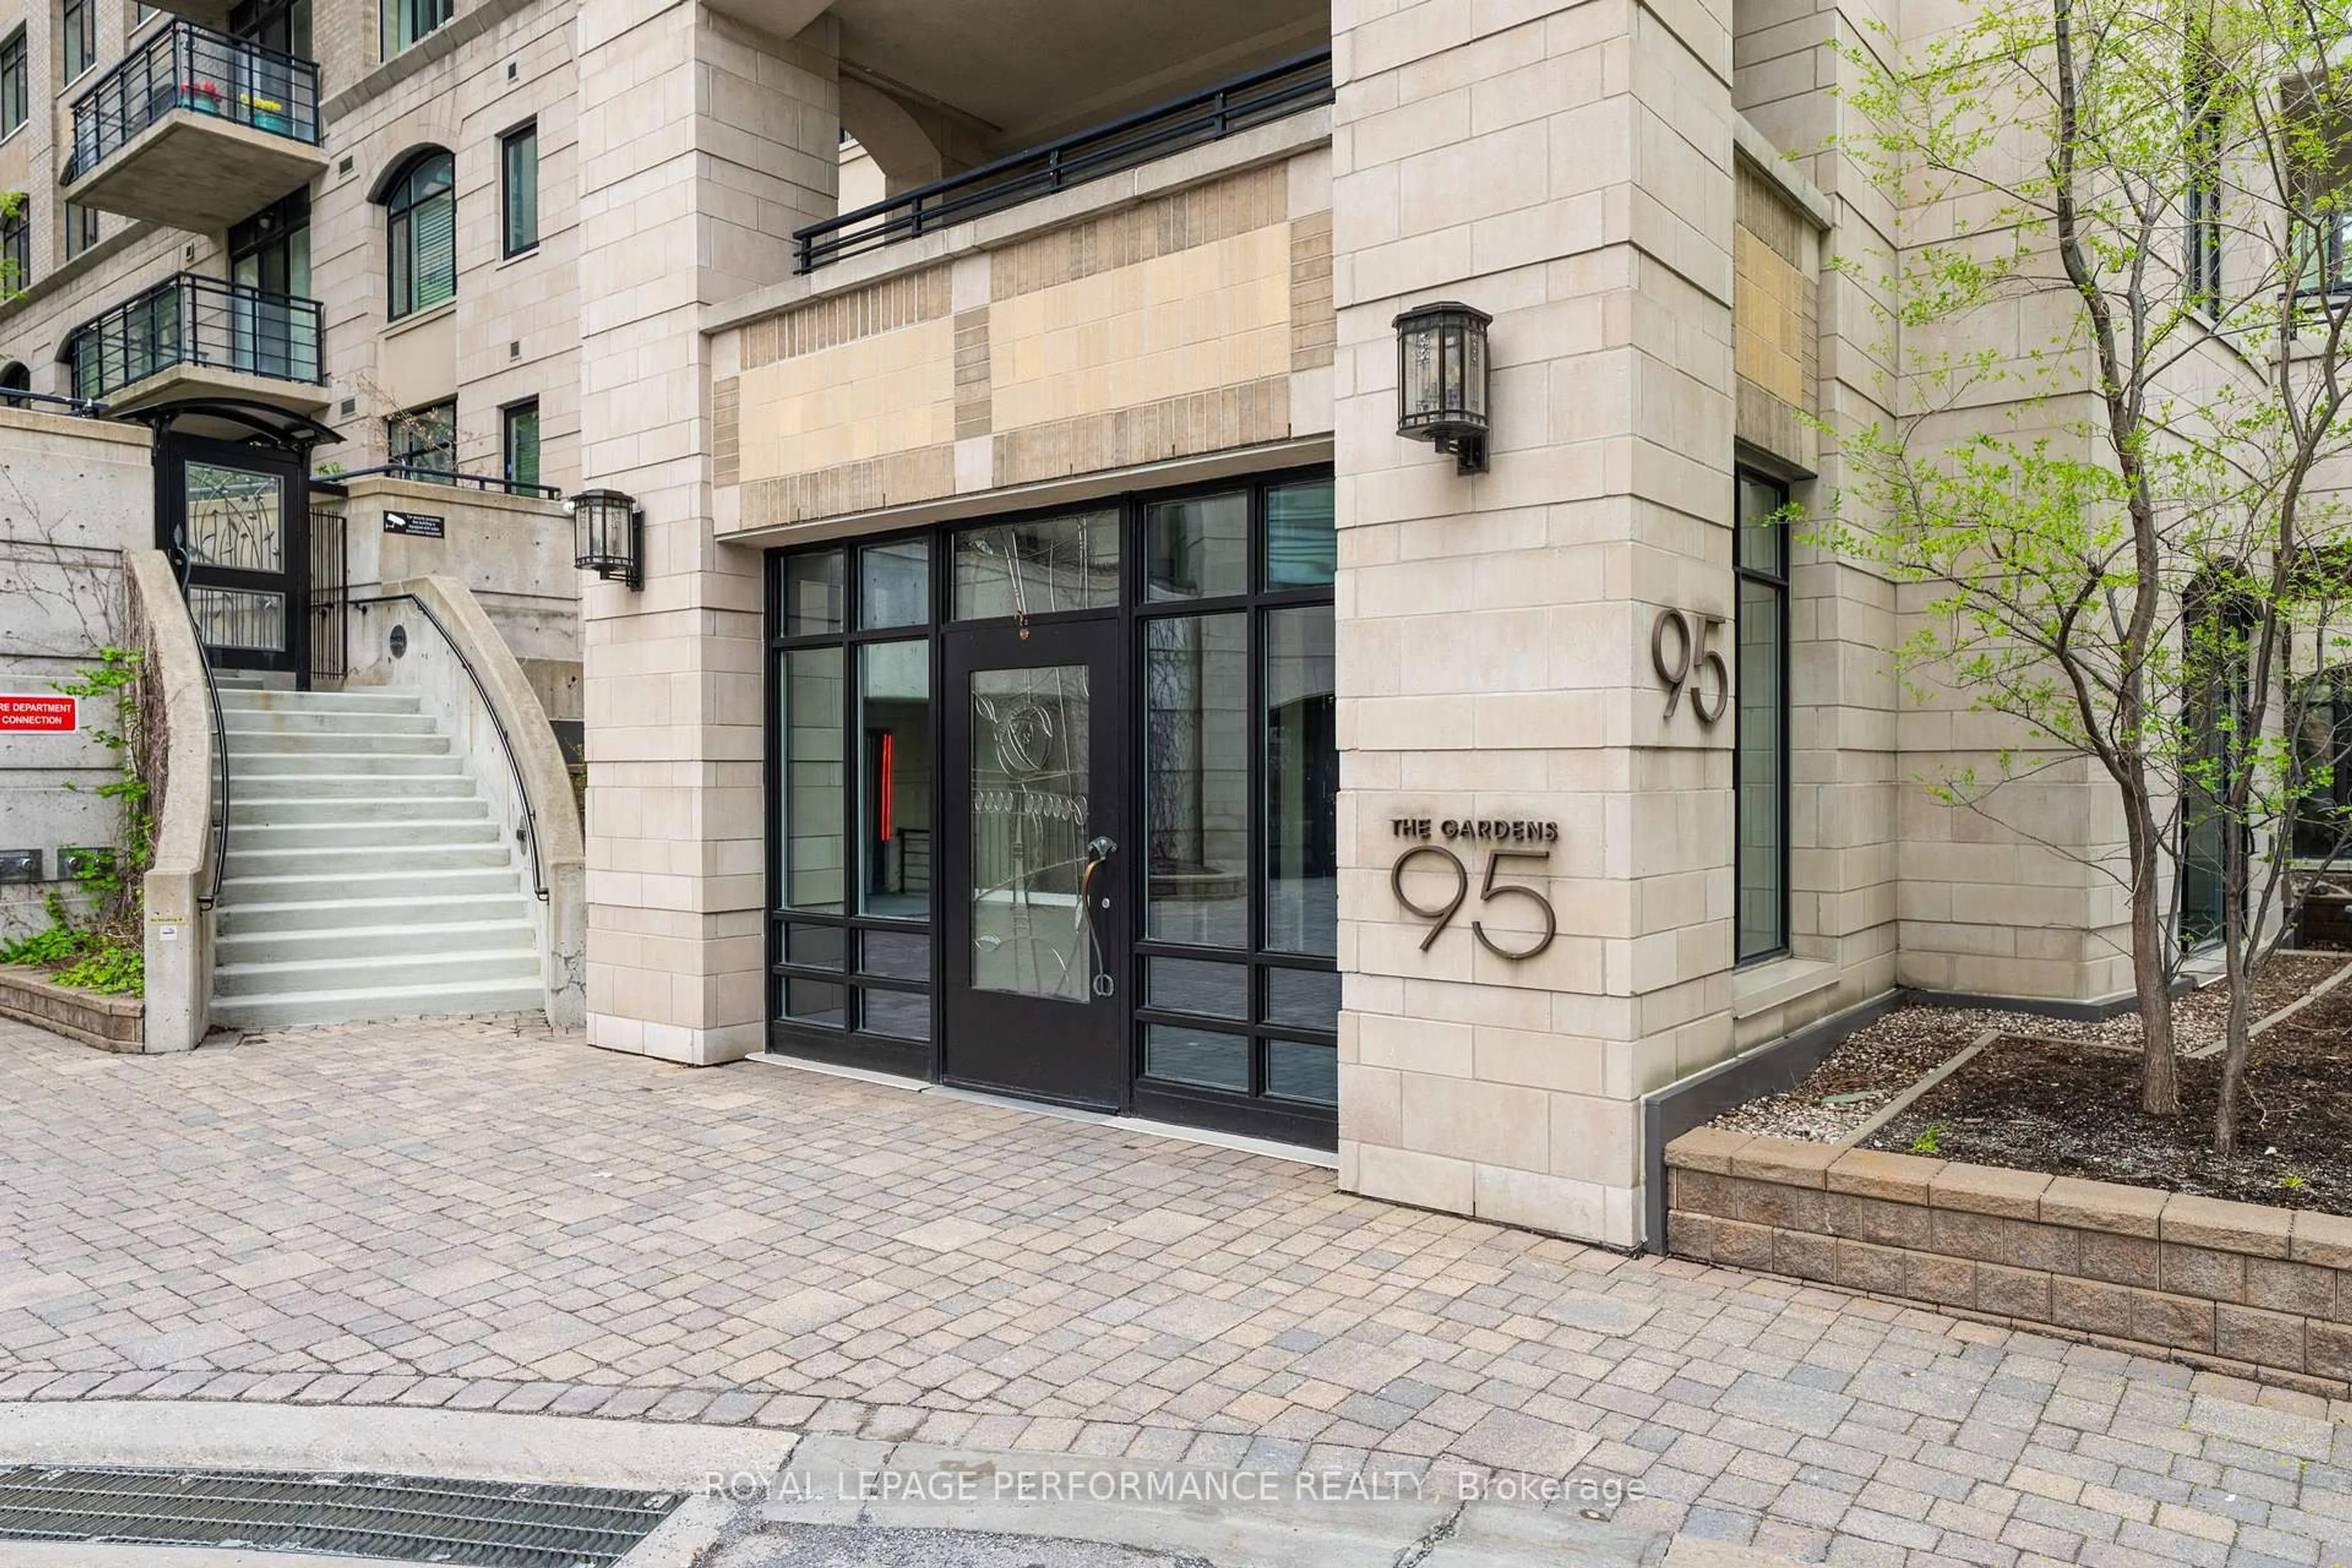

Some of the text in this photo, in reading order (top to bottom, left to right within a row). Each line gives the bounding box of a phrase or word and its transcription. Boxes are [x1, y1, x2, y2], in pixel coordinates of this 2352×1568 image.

[1651, 608, 1728, 725] 95
[13, 703, 72, 713] DEPARTMENT
[2, 715, 62, 725] CONNECTION
[1392, 819, 1558, 842] THE GARDENS
[1390, 845, 1556, 960] 95
